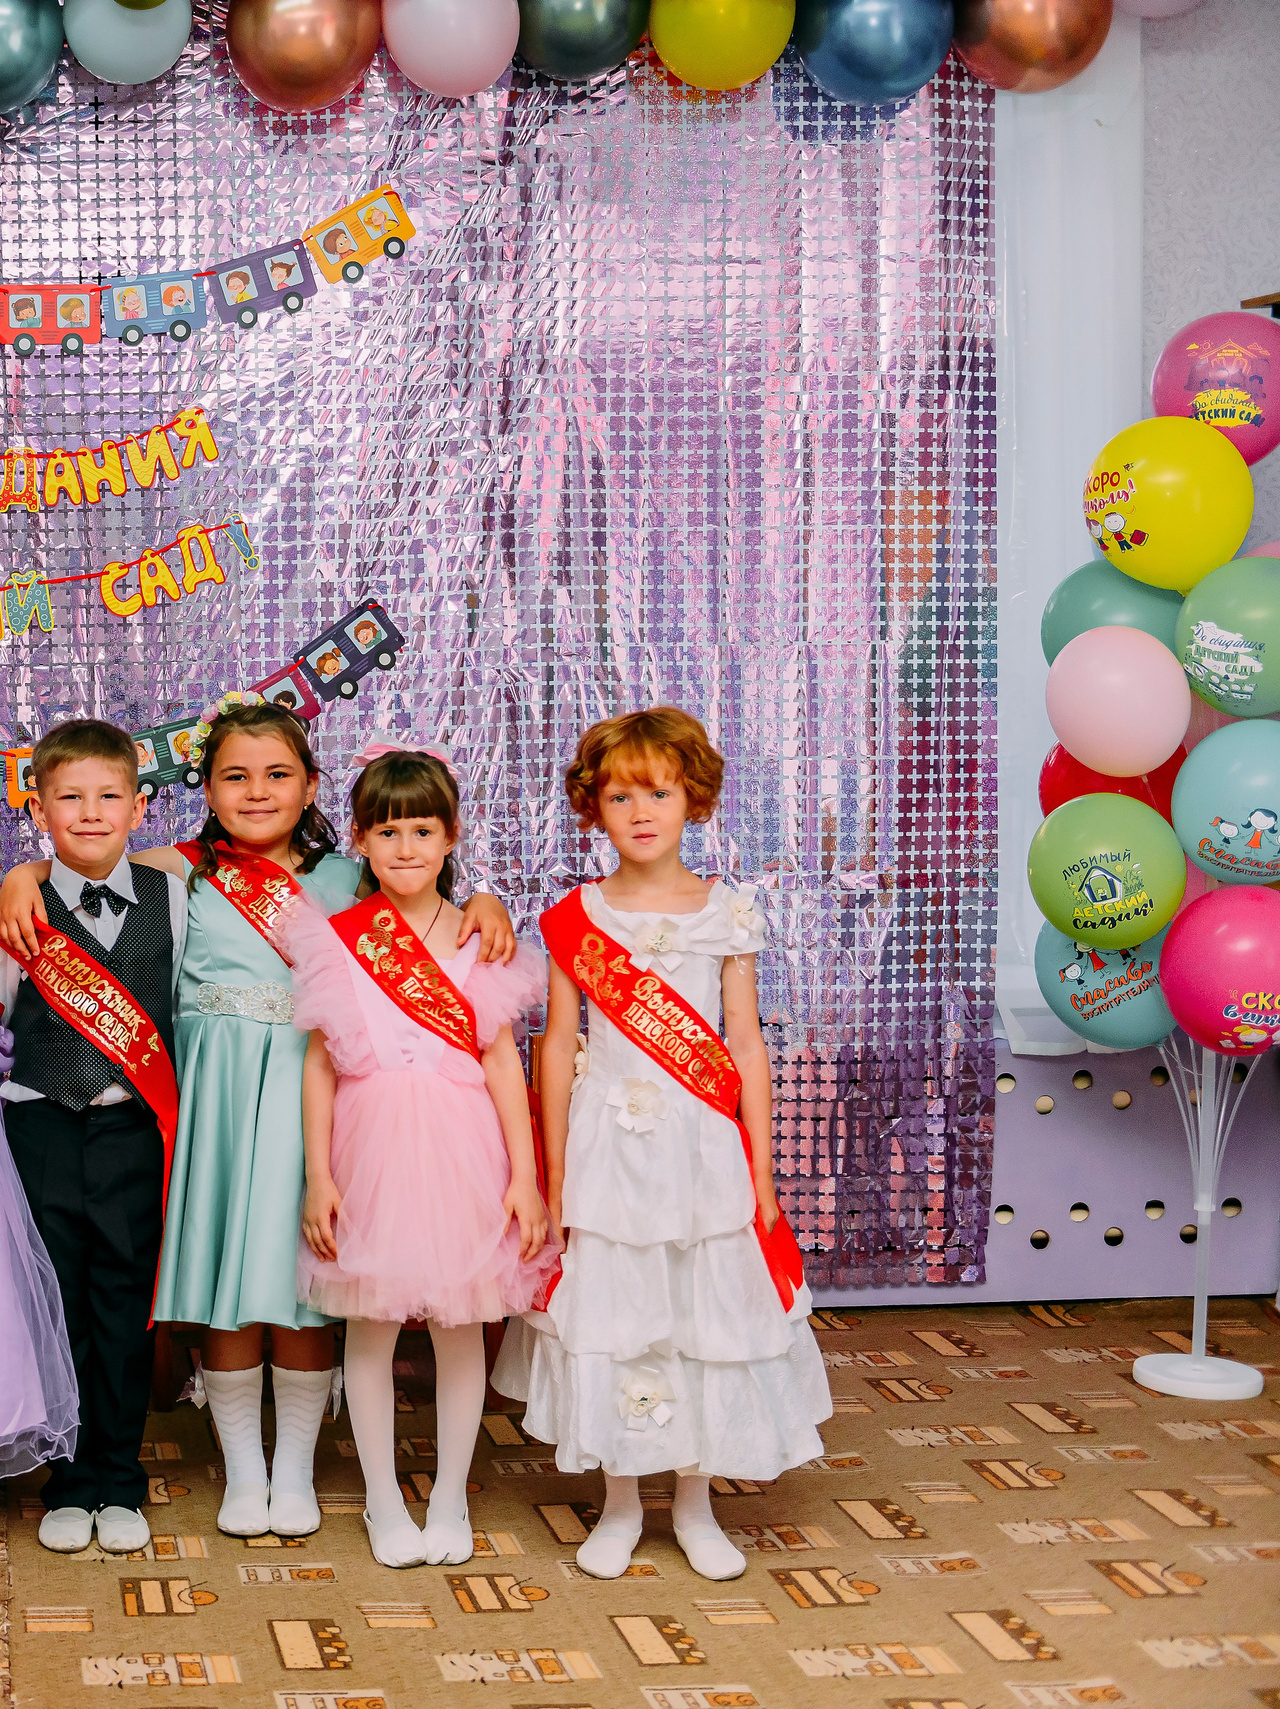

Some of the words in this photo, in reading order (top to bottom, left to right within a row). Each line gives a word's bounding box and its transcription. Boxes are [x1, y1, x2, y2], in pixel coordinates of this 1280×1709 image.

[1192, 643, 1240, 664] ДЕТСКИЙ
[1062, 848, 1132, 881] ЛЮБИМЫЙ
[1072, 889, 1149, 918] ДЕТСКИЙ
[34, 957, 100, 1019] ДЕТСКОГО
[94, 1010, 134, 1053] САДА
[41, 934, 147, 1042] Выпускник
[621, 1001, 692, 1065] ДЕТСКОГО
